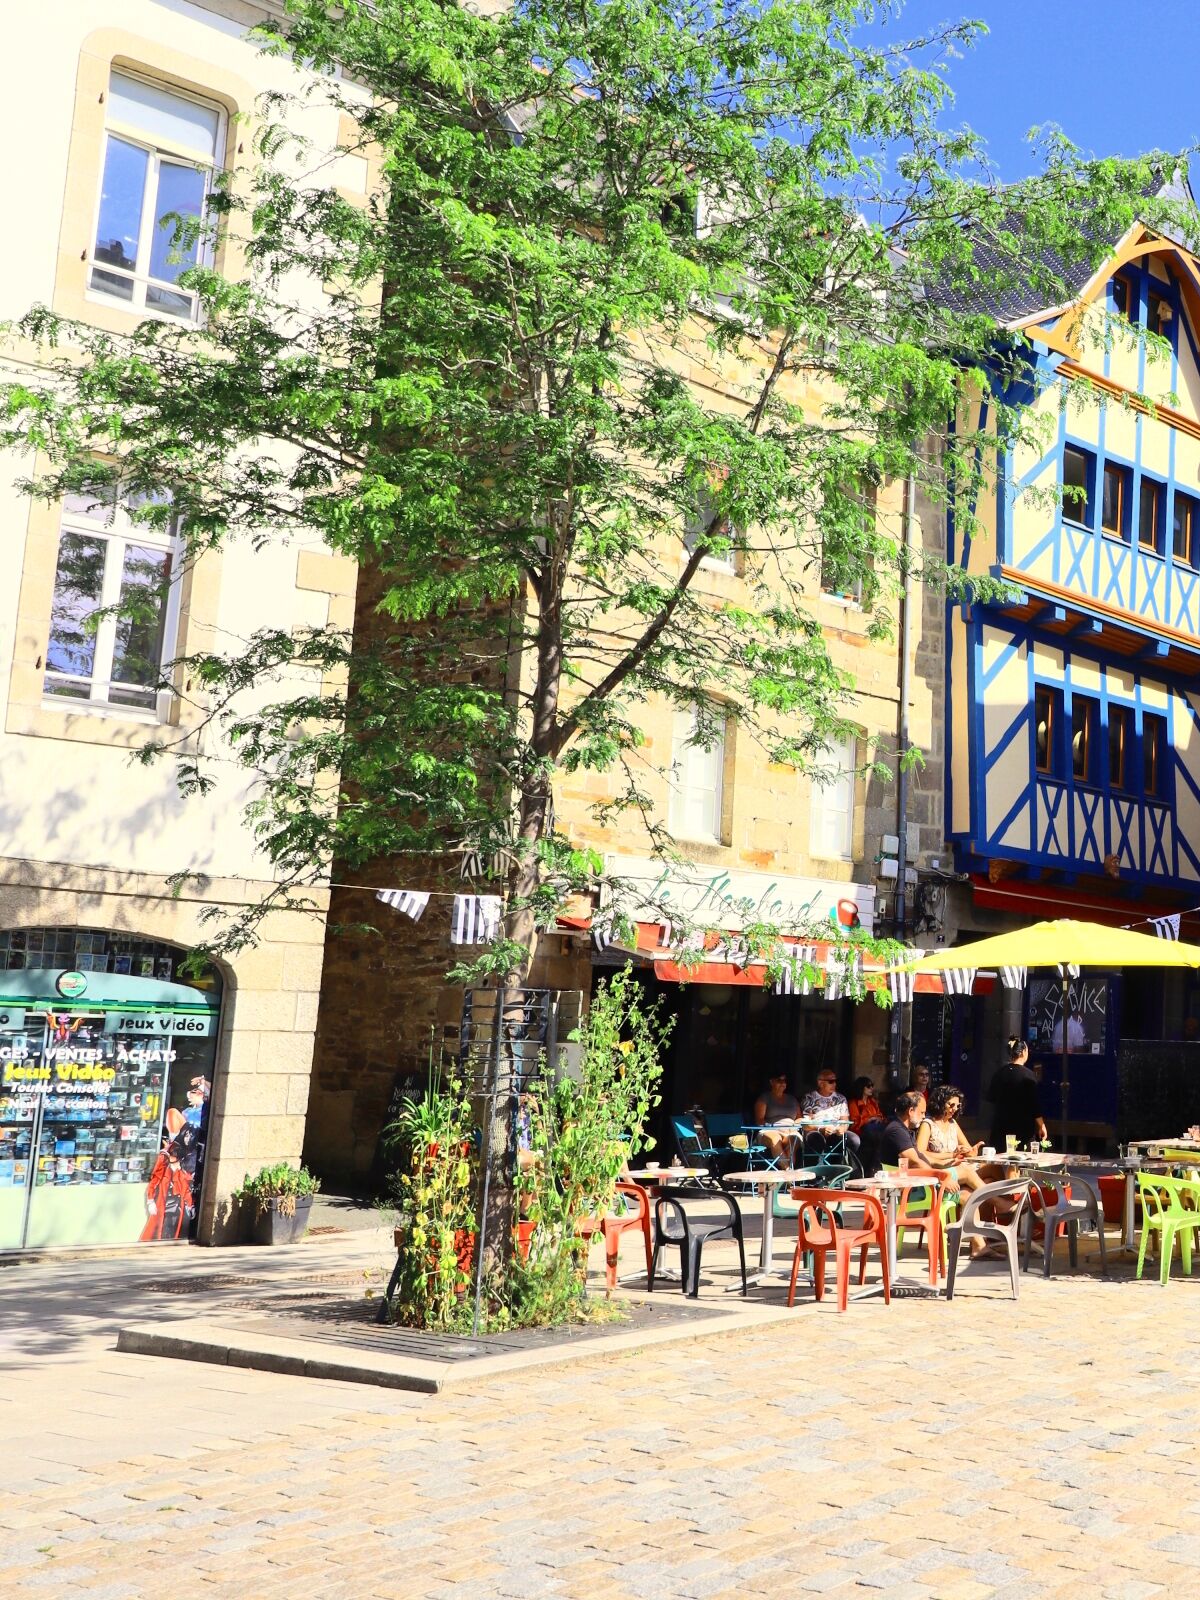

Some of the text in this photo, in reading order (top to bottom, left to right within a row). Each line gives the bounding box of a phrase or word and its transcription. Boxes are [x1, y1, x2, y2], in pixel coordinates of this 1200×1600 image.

[119, 1017, 205, 1032] Jeux Vidéo
[45, 1048, 103, 1060] VENTES
[117, 1049, 177, 1063] ACHATS
[4, 1061, 116, 1081] Jeux Vidéo
[56, 1081, 111, 1094] Consoles
